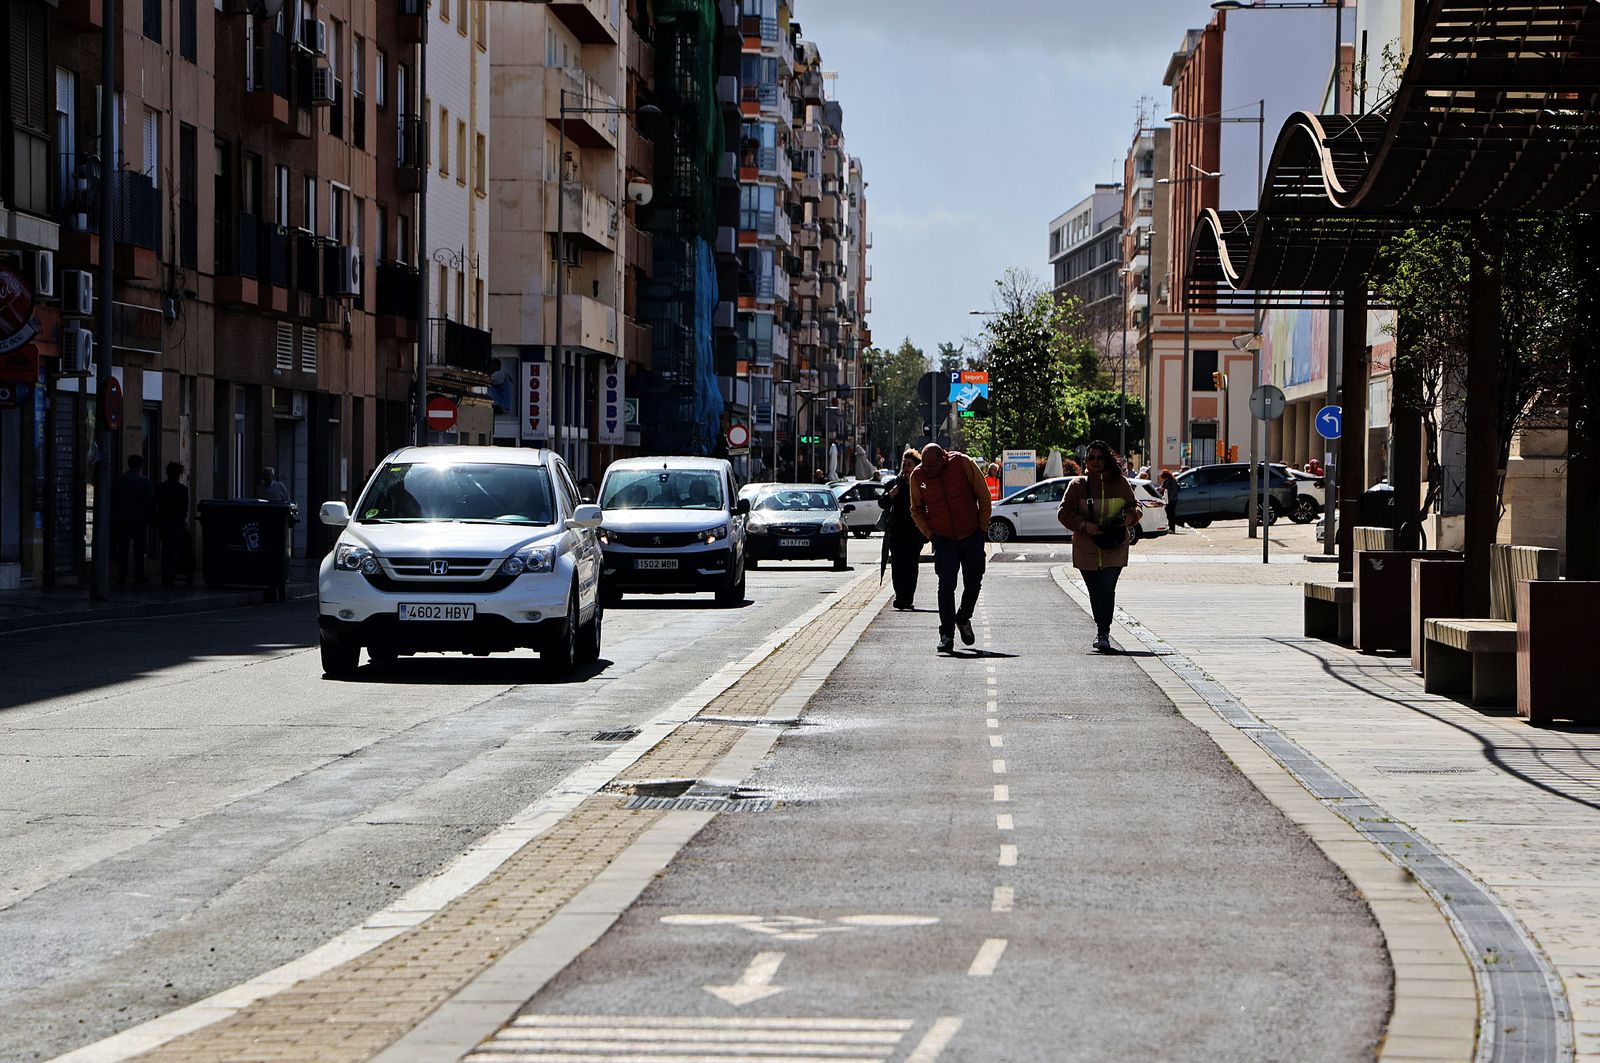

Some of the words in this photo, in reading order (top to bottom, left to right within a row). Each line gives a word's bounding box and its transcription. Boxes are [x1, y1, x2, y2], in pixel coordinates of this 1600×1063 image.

[951, 372, 959, 383] P
[530, 364, 540, 430] HOBBY
[640, 560, 660, 568] 1502
[409, 606, 441, 619] 4602
[445, 606, 470, 619] HBV
